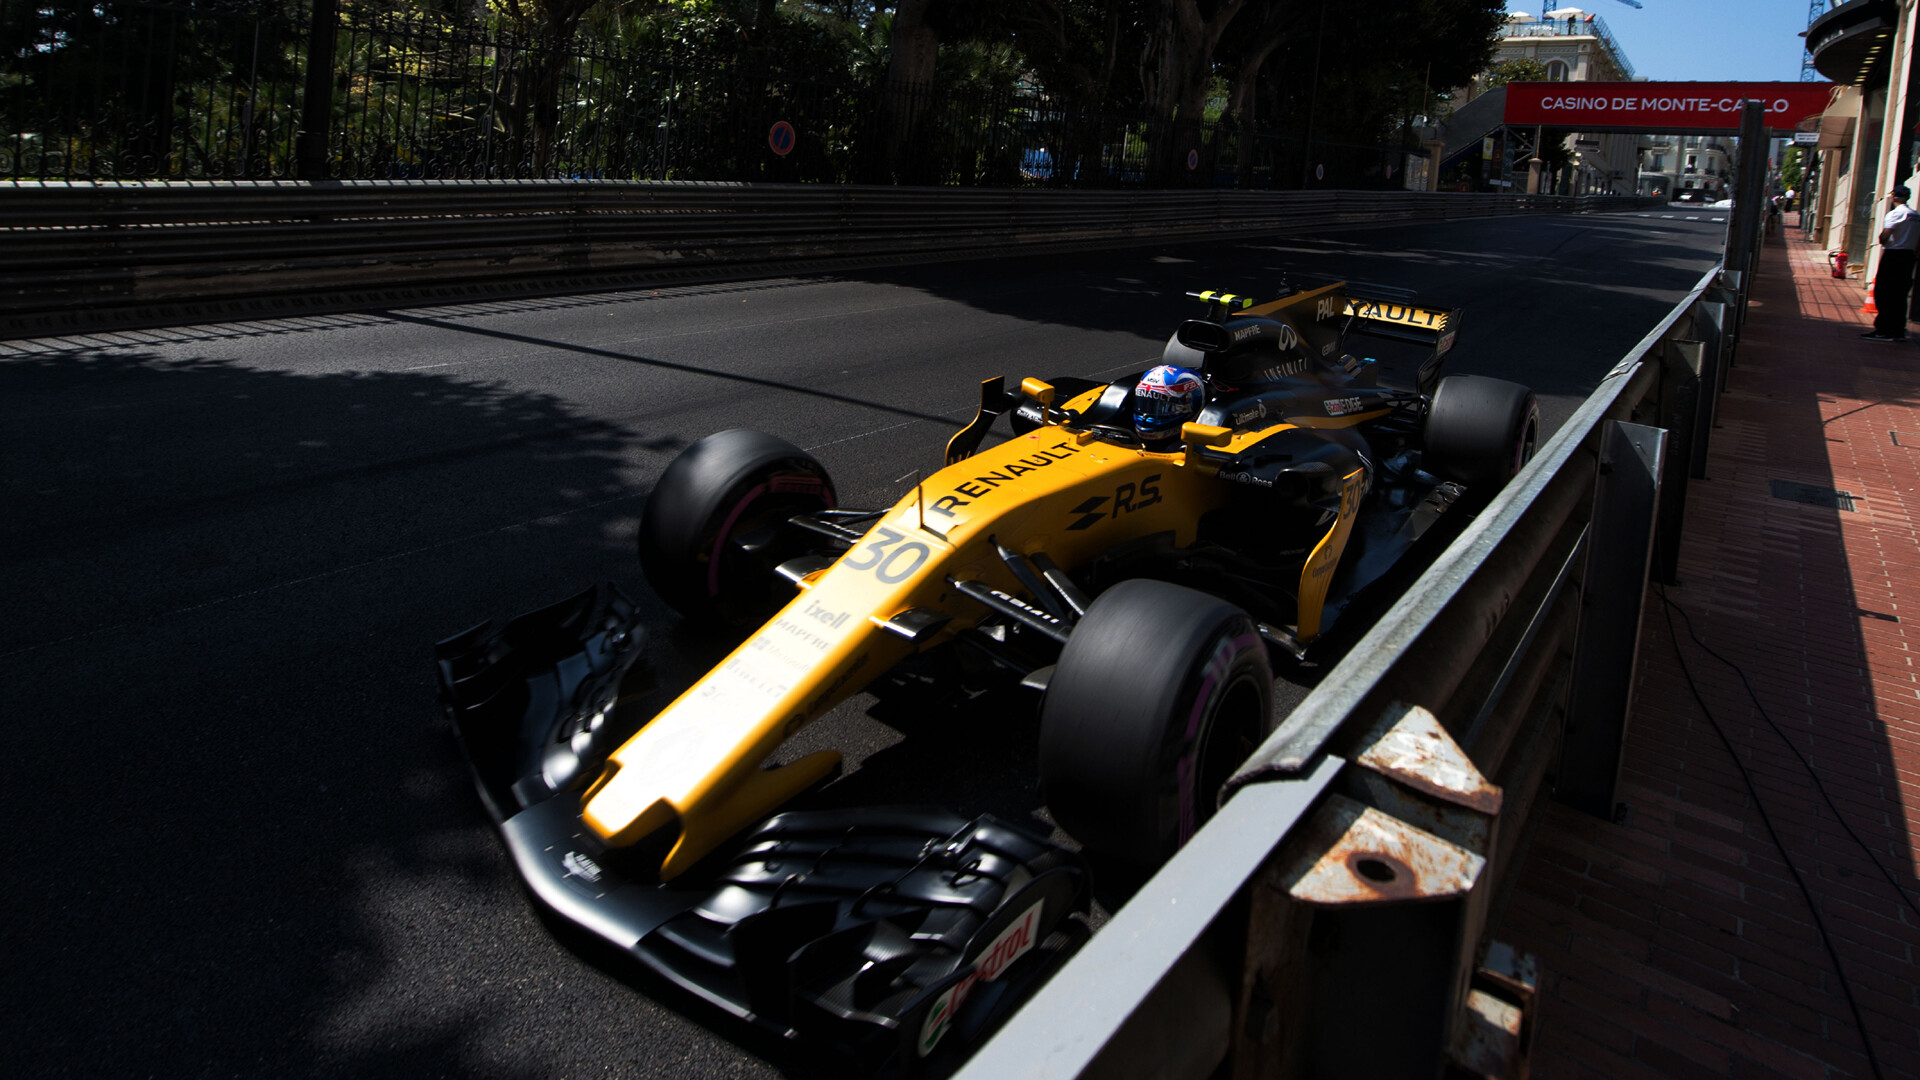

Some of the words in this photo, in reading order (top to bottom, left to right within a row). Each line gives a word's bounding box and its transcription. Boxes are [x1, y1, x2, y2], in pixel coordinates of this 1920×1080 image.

[1541, 97, 1607, 110] CASINO
[1611, 98, 1637, 110] DE
[1641, 98, 1789, 113] MONTE-CALO
[1316, 296, 1335, 322] PAL
[1234, 324, 1261, 341] MAPFRE
[1264, 356, 1307, 382] INFINITI
[1340, 396, 1364, 415] EDGE
[929, 442, 1080, 518] RENAULT
[1252, 477, 1272, 488] Ross
[1112, 474, 1162, 519] R.S.
[1343, 481, 1362, 519] 30
[843, 528, 930, 584] 30
[803, 600, 851, 630] ixell
